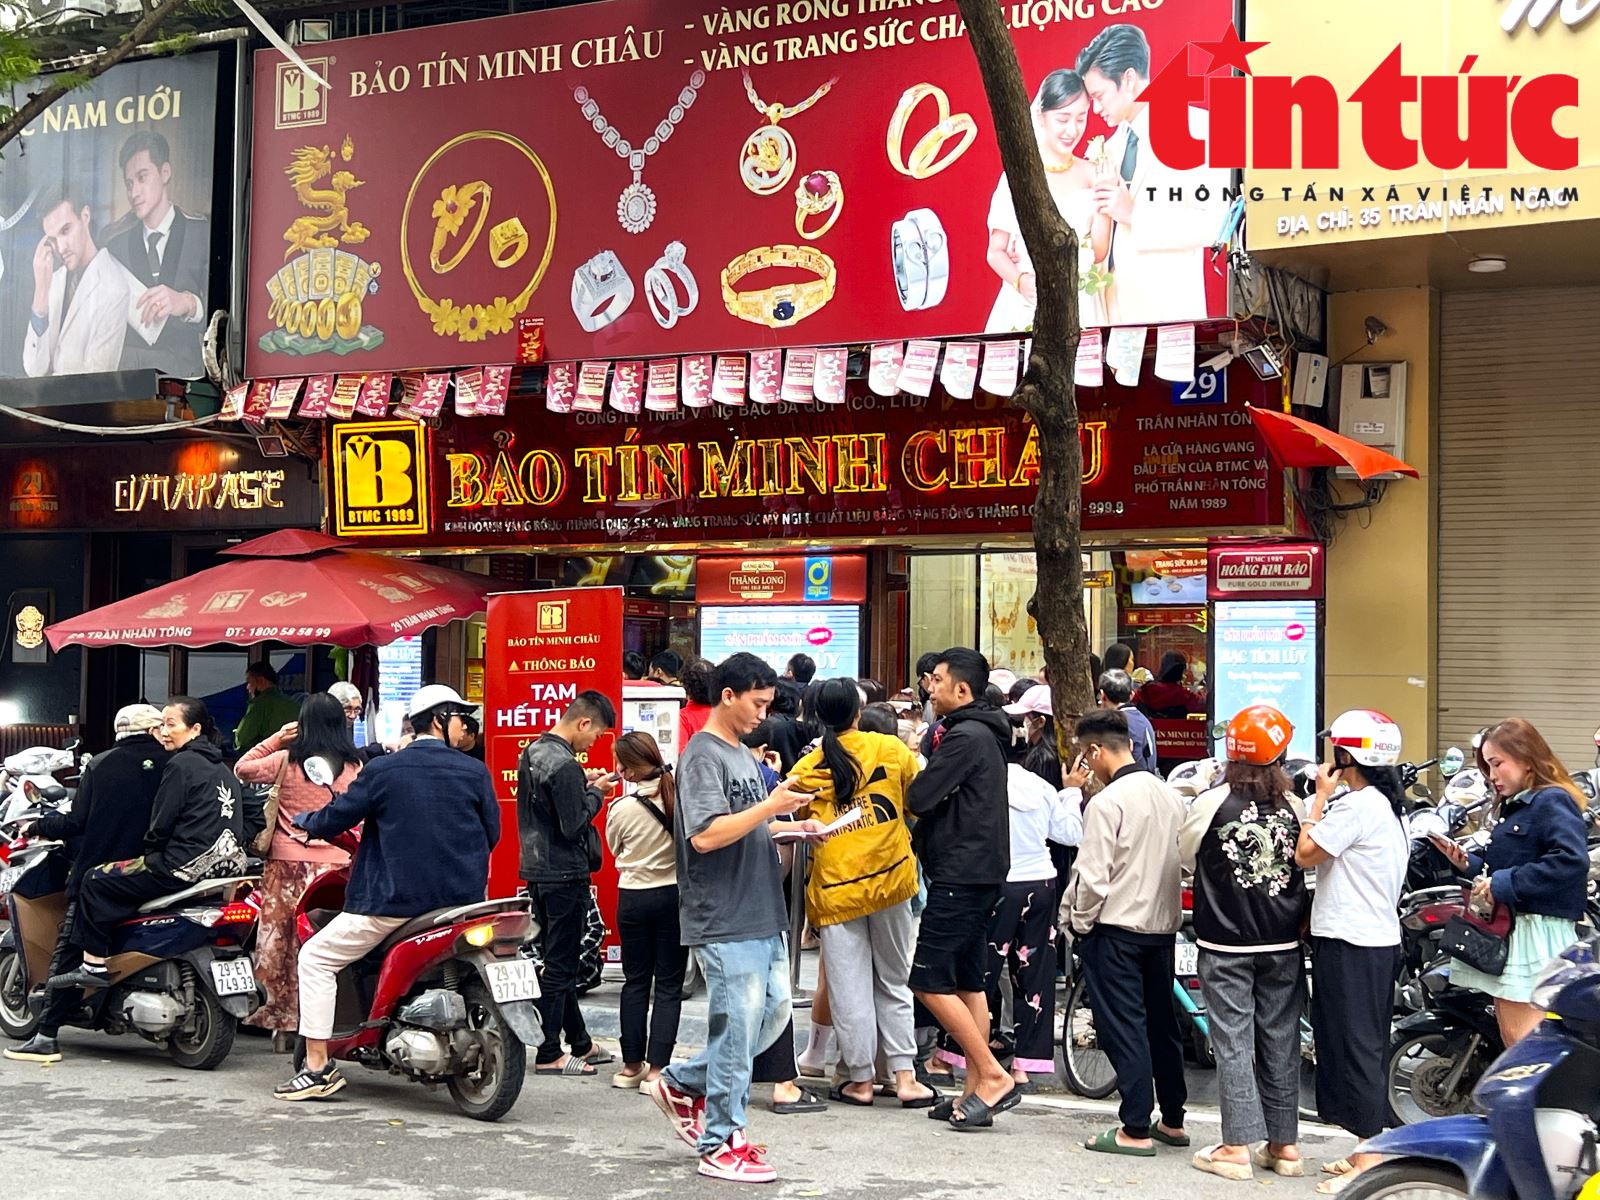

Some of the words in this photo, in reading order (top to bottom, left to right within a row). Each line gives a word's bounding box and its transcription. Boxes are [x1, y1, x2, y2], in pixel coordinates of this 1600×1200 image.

[703, 5, 770, 36] VÀNG
[701, 42, 768, 71] VÀNG
[774, 29, 858, 62] TRANG
[863, 16, 914, 50] SỨC
[349, 60, 411, 97] BẢO
[418, 51, 469, 88] TÍN
[477, 43, 563, 81] MINH
[571, 25, 664, 68] CHÂU
[42, 100, 107, 134] NAM
[115, 86, 182, 125] GIỚI
[1359, 208, 1381, 226] 35
[1180, 371, 1217, 400] 29
[1221, 411, 1252, 427] TÔN
[446, 430, 563, 507] BẢO
[575, 428, 686, 503] TÍN
[698, 433, 888, 498] MINH
[1216, 460, 1250, 472] BTMC
[1202, 498, 1227, 509] 1989
[349, 509, 381, 523] BTMC
[384, 508, 414, 522] 1989
[1260, 564, 1282, 576] KIM
[761, 576, 783, 584] LONG
[249, 627, 278, 637] 1800
[280, 628, 296, 637] 58
[297, 628, 312, 637] 58
[314, 628, 331, 638] 99
[546, 636, 572, 645] MINH
[522, 657, 567, 671] THÔNG
[569, 655, 596, 669] BÁO
[531, 683, 577, 705] TẠM
[497, 702, 541, 727] HẾT
[142, 916, 176, 926] LEAD
[217, 961, 248, 976] 29-E1
[494, 963, 527, 982] 29-V7
[218, 976, 254, 993] 749.33
[495, 980, 536, 999] 372.47
